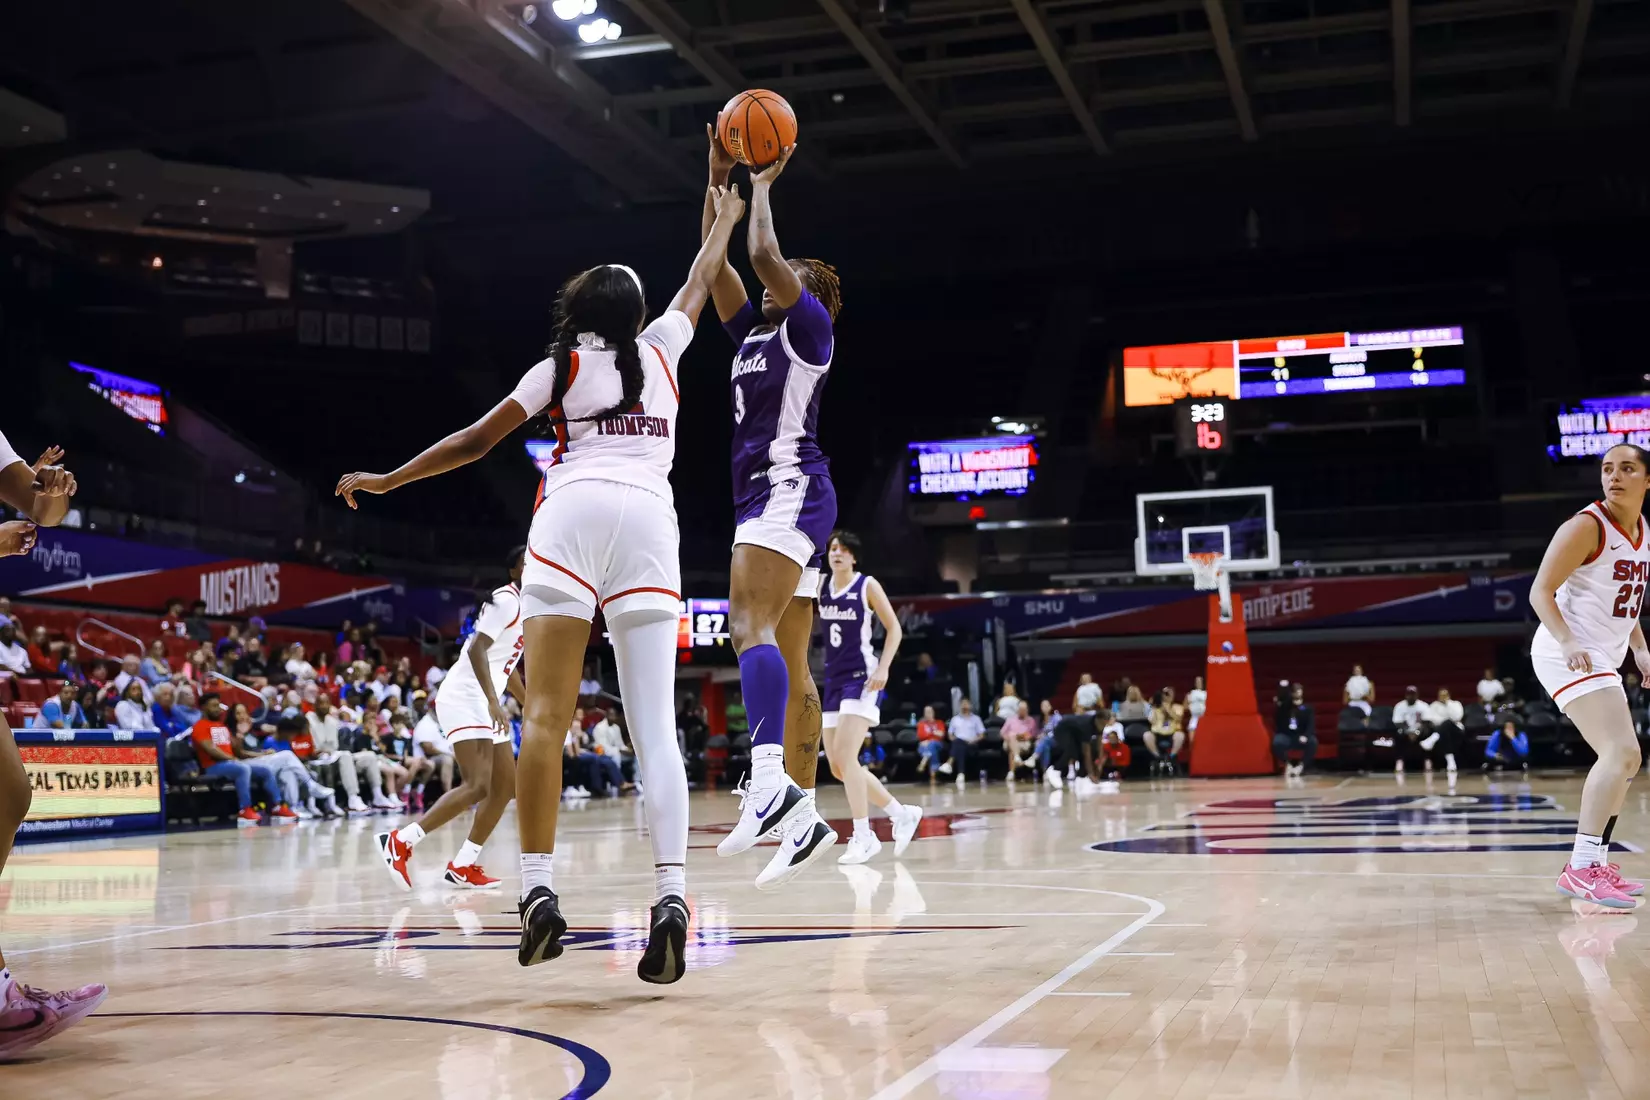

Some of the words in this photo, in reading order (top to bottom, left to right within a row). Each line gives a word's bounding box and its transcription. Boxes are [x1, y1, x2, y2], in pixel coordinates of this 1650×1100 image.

[1190, 403, 1225, 423] 3:23
[597, 415, 670, 438] THOMPSON
[200, 562, 280, 615] MUSTANGS
[1024, 600, 1065, 615] SMU
[1243, 586, 1315, 621] AMPEDE
[1612, 584, 1644, 618] 23
[697, 614, 725, 633] 27
[830, 623, 842, 648] 6
[56, 771, 99, 791] TEXAS
[104, 770, 153, 789] BAR-B-Q
